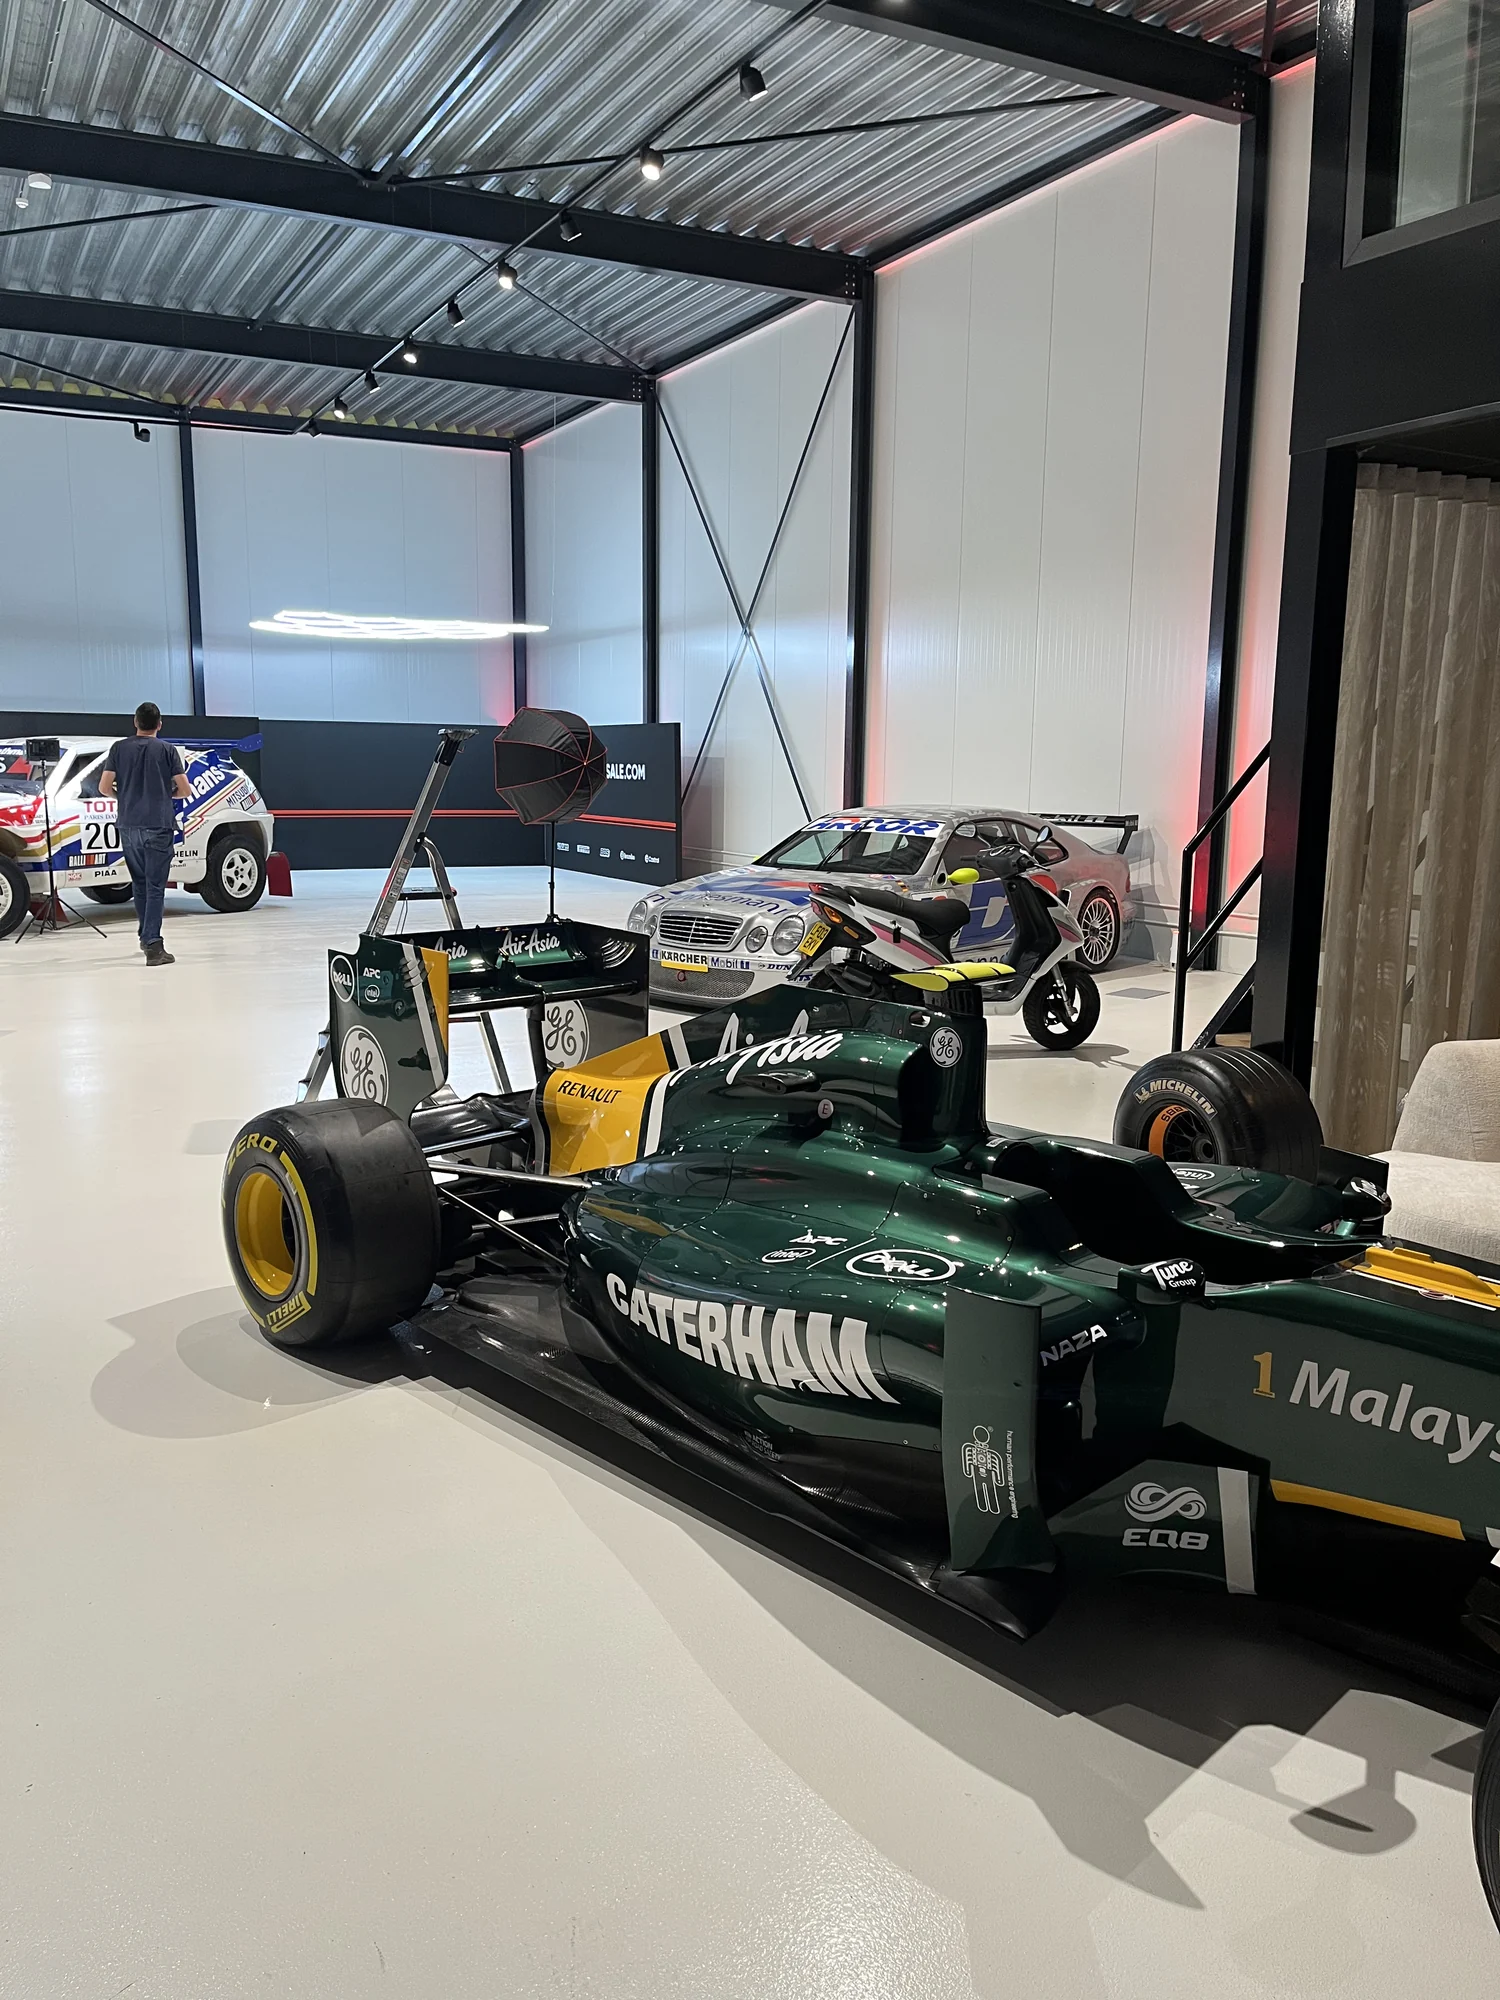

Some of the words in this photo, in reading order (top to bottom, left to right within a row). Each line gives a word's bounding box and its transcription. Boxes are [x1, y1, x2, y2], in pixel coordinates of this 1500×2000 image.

[606, 763, 646, 780] SALE.COM
[83, 800, 116, 813] TOT
[85, 822, 120, 850] 20
[807, 817, 940, 835] ARCOR
[94, 869, 118, 877] PIAA
[661, 951, 708, 965] KÄRCHER
[711, 957, 738, 969] Mobil
[333, 970, 352, 987] DELL
[363, 967, 381, 979] APC
[557, 1080, 622, 1104] RENAULT
[1149, 1079, 1215, 1115] MICHELIN
[226, 1133, 278, 1175] ZERO
[1141, 1259, 1193, 1290] Tune
[1169, 1276, 1197, 1288] Group
[266, 1291, 311, 1333] PIRELLI
[606, 1273, 900, 1405] CATERHAM
[1040, 1324, 1107, 1366] NAZA
[1253, 1352, 1275, 1398] 1
